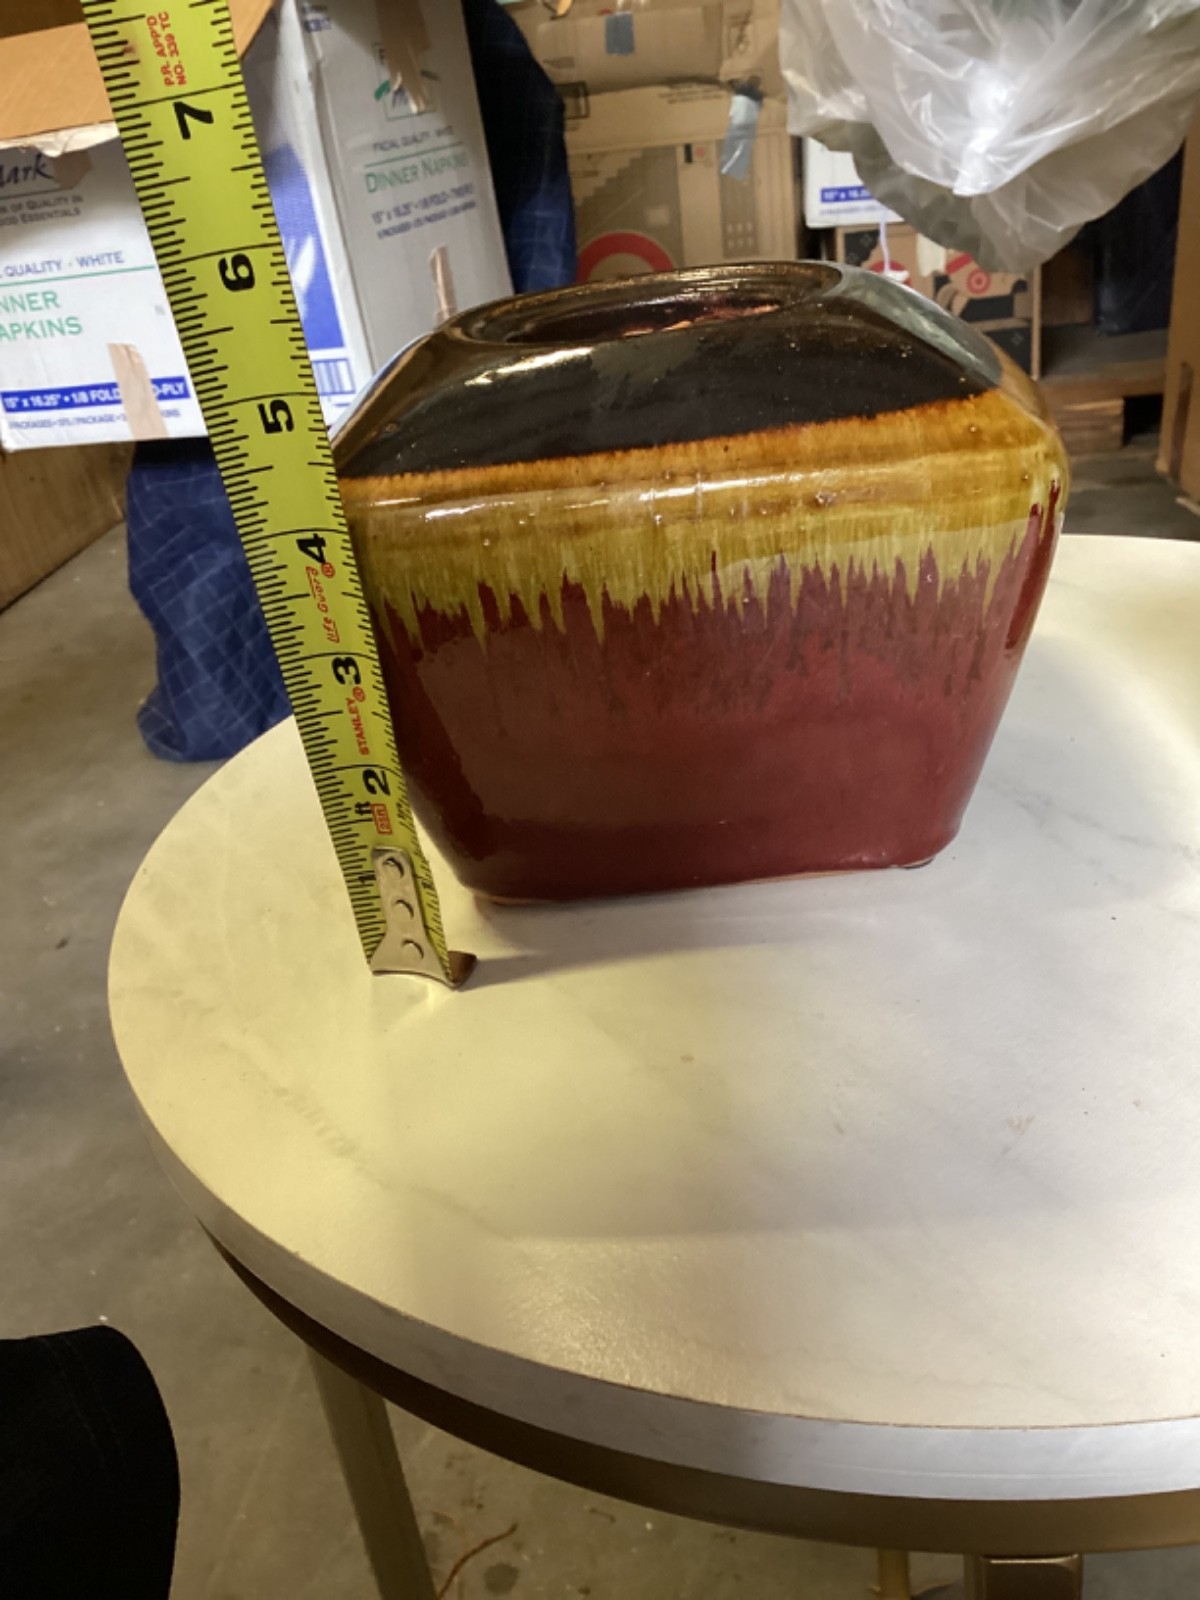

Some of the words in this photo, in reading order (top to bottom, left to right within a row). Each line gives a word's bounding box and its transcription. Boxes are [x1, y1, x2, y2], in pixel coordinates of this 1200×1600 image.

[172, 101, 214, 140] 7
[3, 259, 62, 277] QUALITY
[76, 250, 124, 268] WHITE
[218, 253, 256, 292] 6
[151, 382, 185, 396] O-PLY
[257, 399, 295, 435] 5
[296, 533, 327, 564] 4
[332, 656, 361, 686] 3
[345, 697, 371, 756] STANLEY
[362, 768, 391, 796] 2
